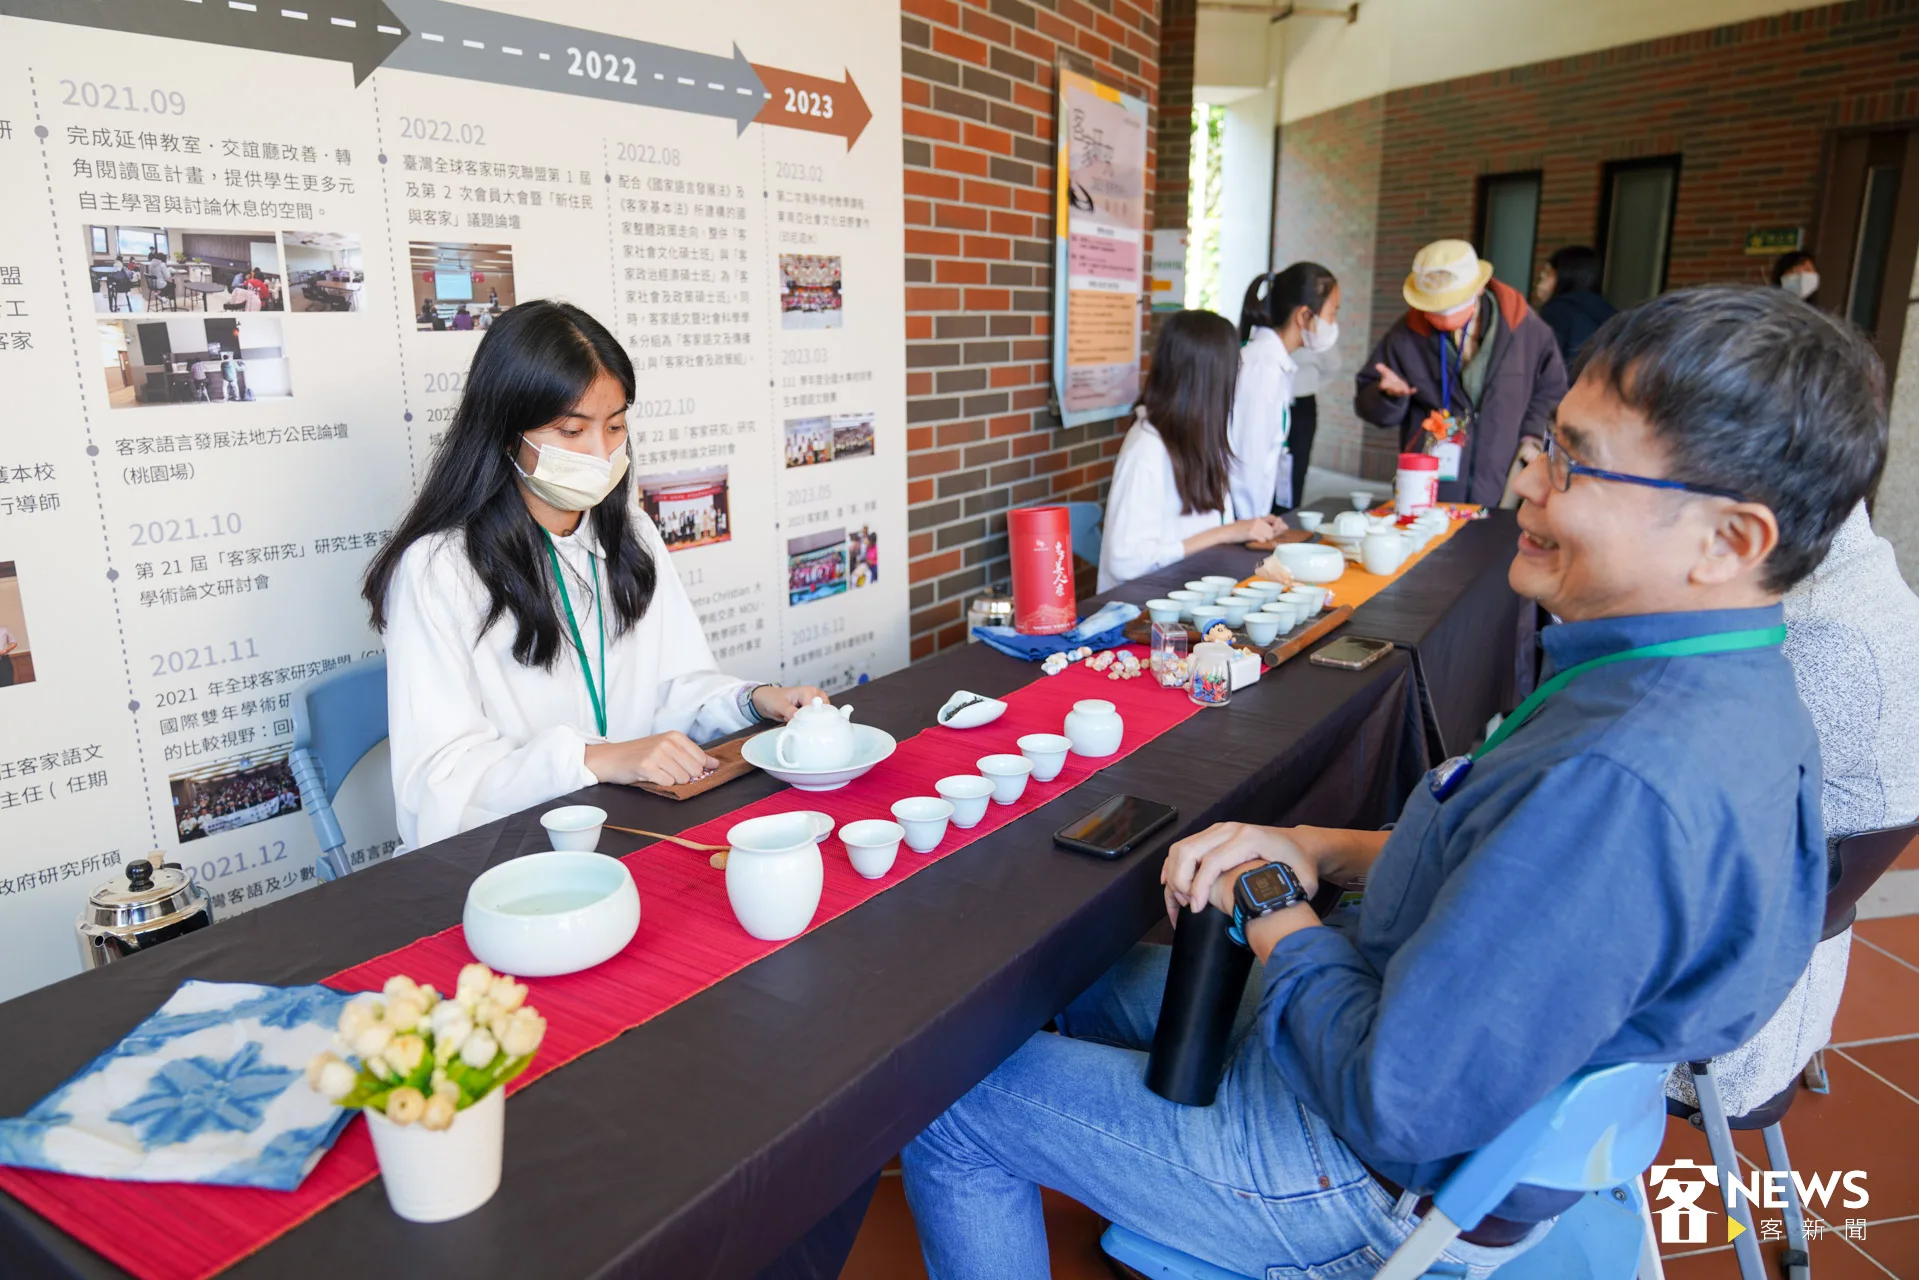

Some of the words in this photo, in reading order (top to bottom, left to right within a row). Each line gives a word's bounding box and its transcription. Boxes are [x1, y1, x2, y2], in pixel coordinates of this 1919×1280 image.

[567, 47, 638, 85] 2022
[59, 79, 187, 116] 2021.09
[785, 87, 834, 119] 2023
[400, 116, 487, 146] 2022.02
[617, 142, 681, 167] 2022.08
[405, 182, 436, 200] 及第
[444, 186, 452, 199] 2
[635, 397, 696, 420] 2022.10
[115, 422, 350, 457] 客家語言發展法地方公民論壇
[129, 512, 243, 547] 2021.10
[135, 561, 154, 581] 第
[162, 559, 183, 577] 21
[139, 573, 270, 609] 學術論文研討會
[150, 636, 261, 680] 2021.11
[154, 687, 199, 709] 2021
[163, 718, 294, 762] 的比較視野：回
[185, 840, 289, 885] 2021.12
